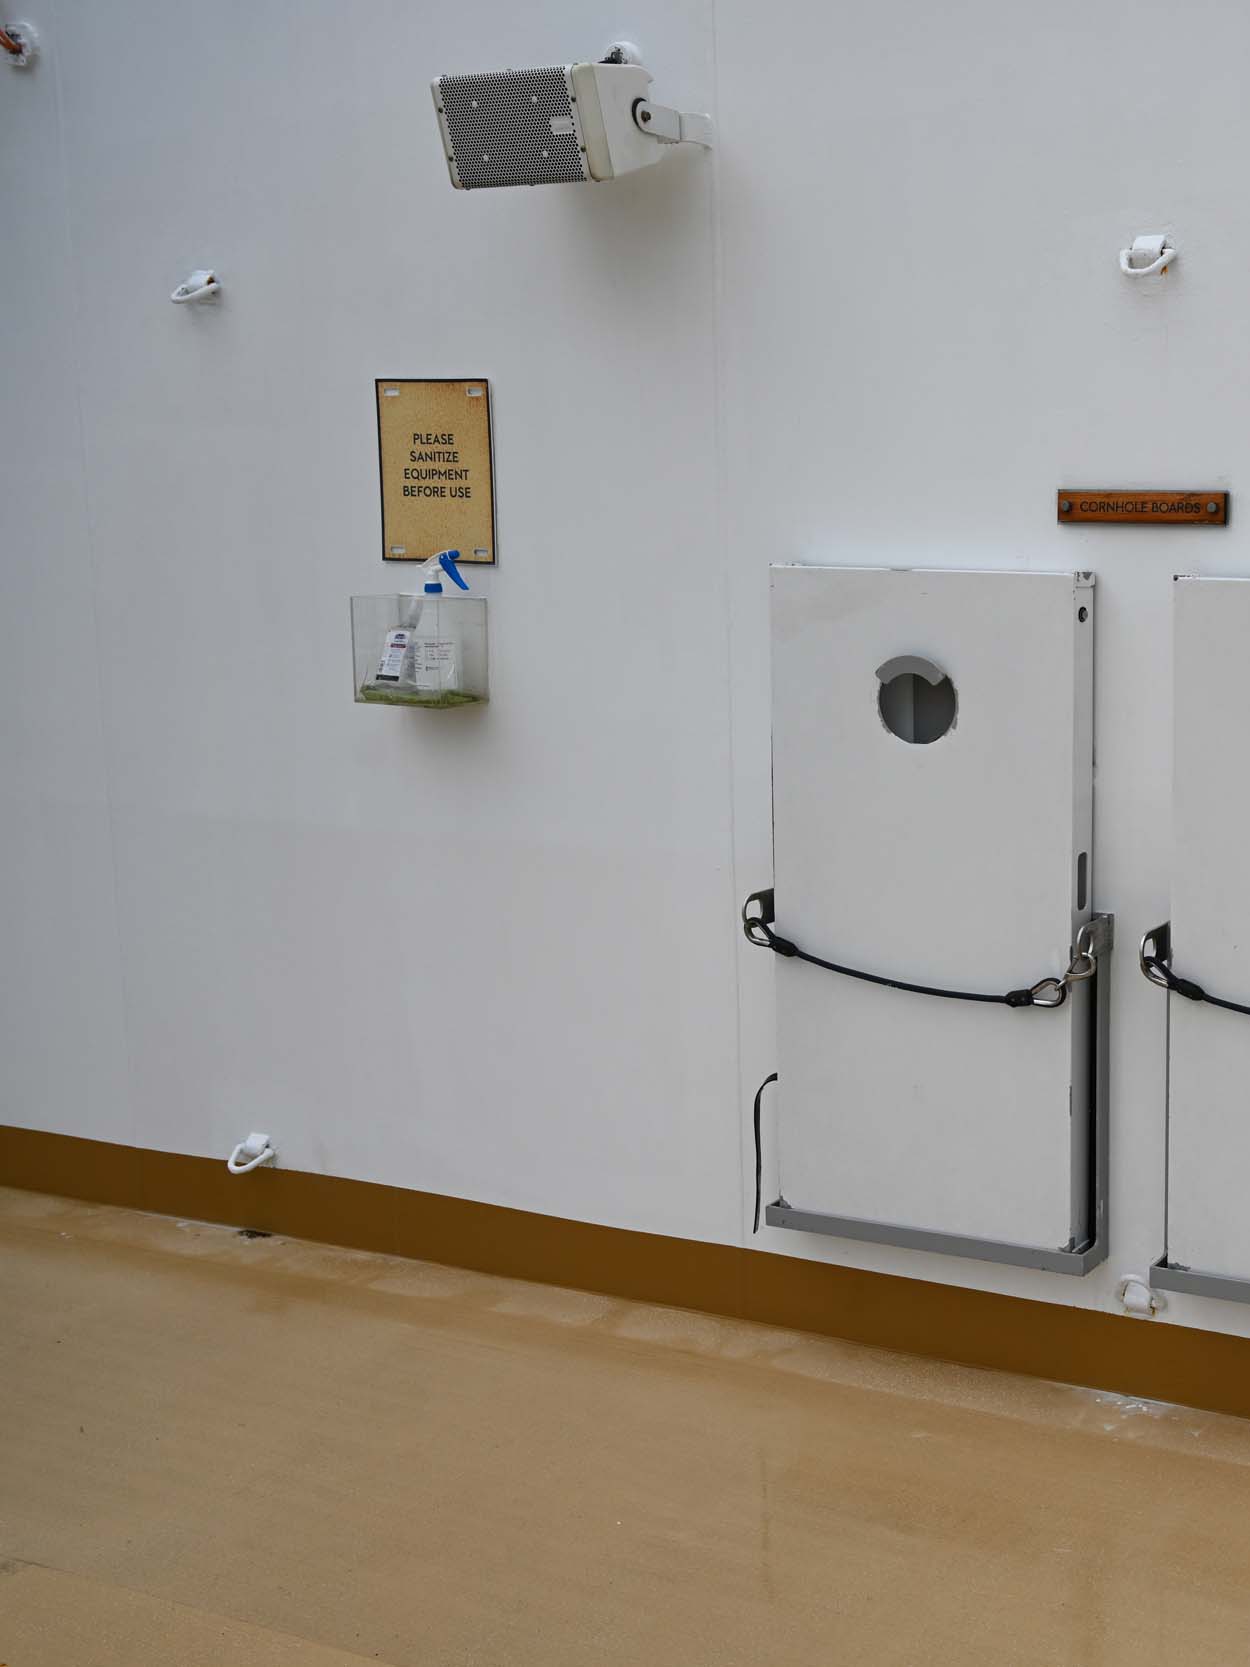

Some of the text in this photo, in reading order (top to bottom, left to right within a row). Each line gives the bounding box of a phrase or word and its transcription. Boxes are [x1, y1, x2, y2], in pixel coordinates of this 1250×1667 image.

[413, 433, 454, 445] PLEASE
[410, 451, 459, 463] SANITIZE
[404, 468, 469, 481] EQUIPMENT
[403, 486, 471, 499] BEFORE USE
[1080, 501, 1201, 514] CORNHOLE BOARDS
